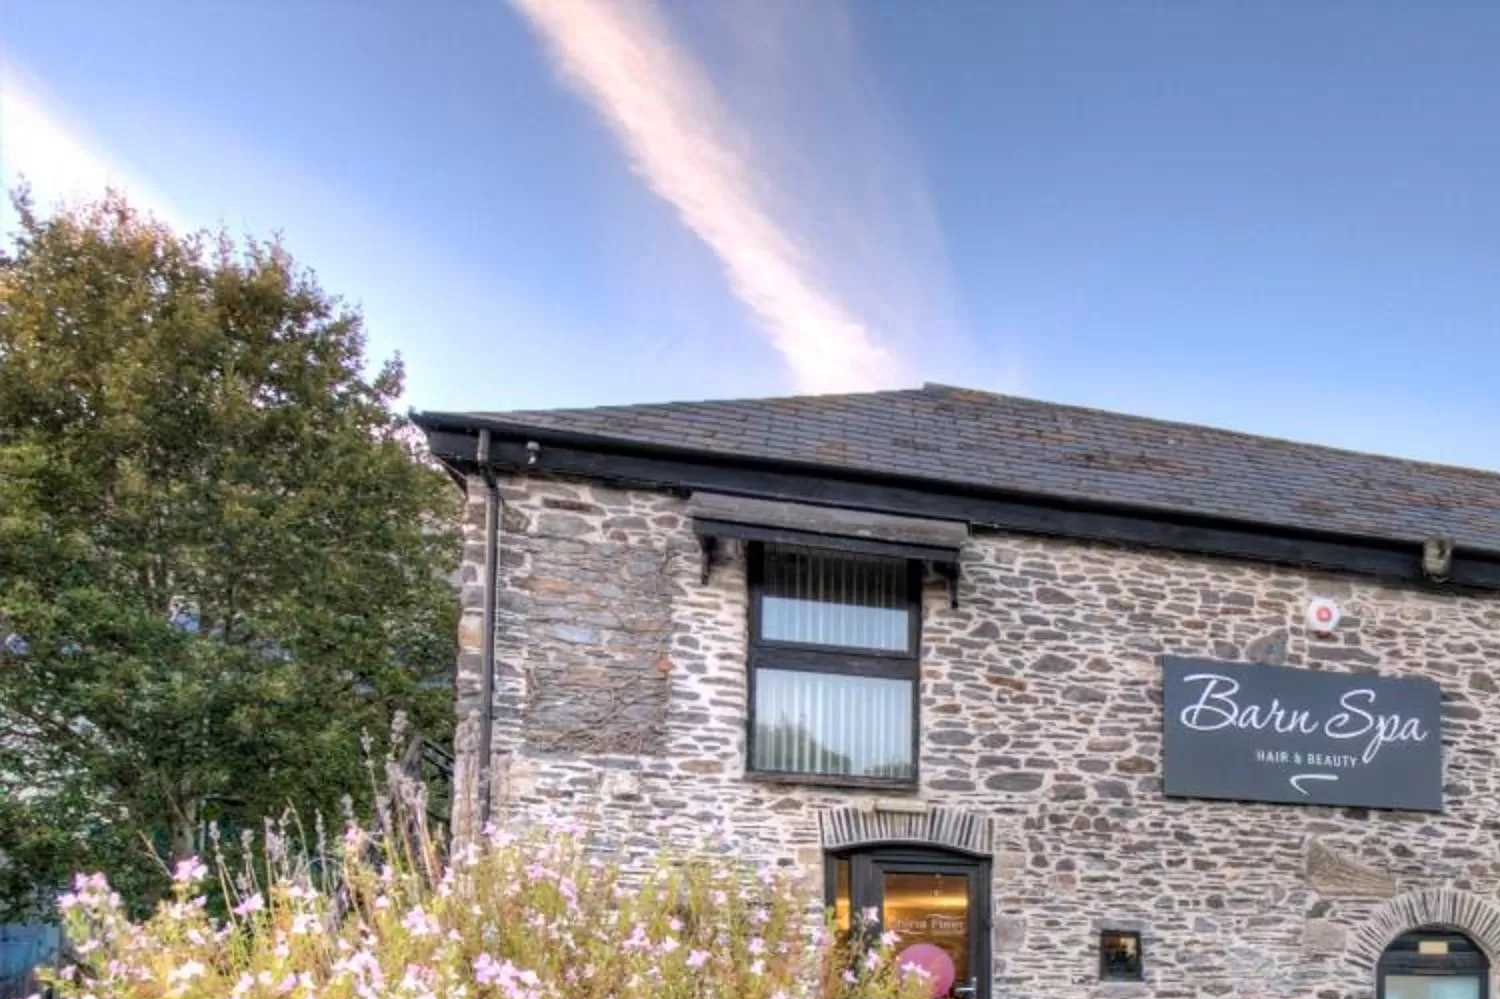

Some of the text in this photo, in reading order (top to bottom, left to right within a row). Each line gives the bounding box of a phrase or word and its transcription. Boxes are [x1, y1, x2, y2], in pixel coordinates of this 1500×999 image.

[1180, 674, 1429, 765] Barn Spa
[1257, 750, 1358, 768] HAIR & BEAUTY
